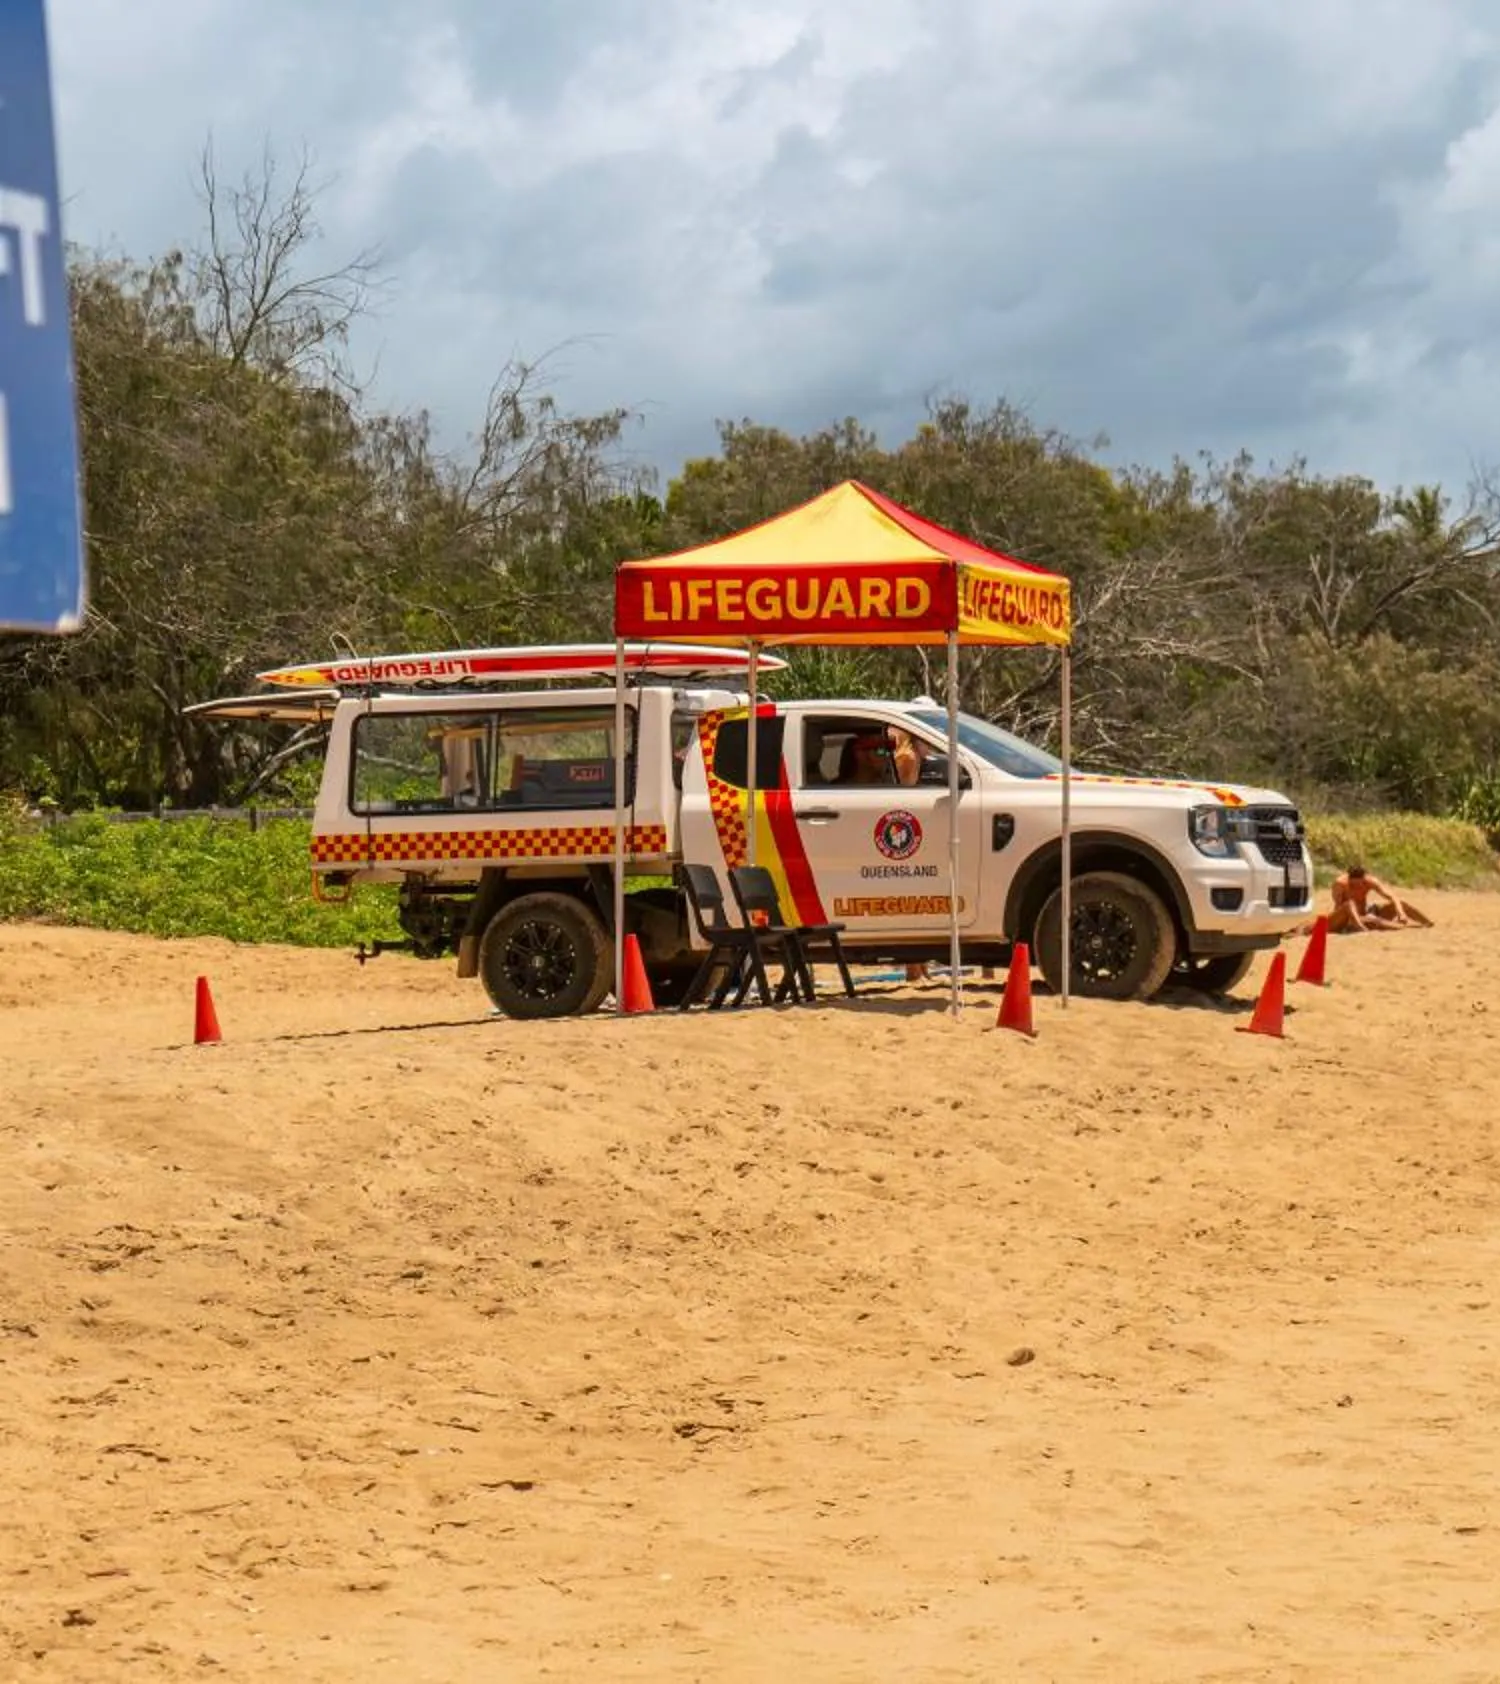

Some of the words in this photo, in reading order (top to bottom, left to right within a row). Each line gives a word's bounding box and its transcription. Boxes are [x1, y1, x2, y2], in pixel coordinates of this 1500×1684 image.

[642, 577, 931, 620] LIFEGUARD
[963, 575, 1063, 629] LIFEGUARD
[336, 659, 468, 682] LIFEGUARD
[860, 864, 938, 879] QUEENSLAND
